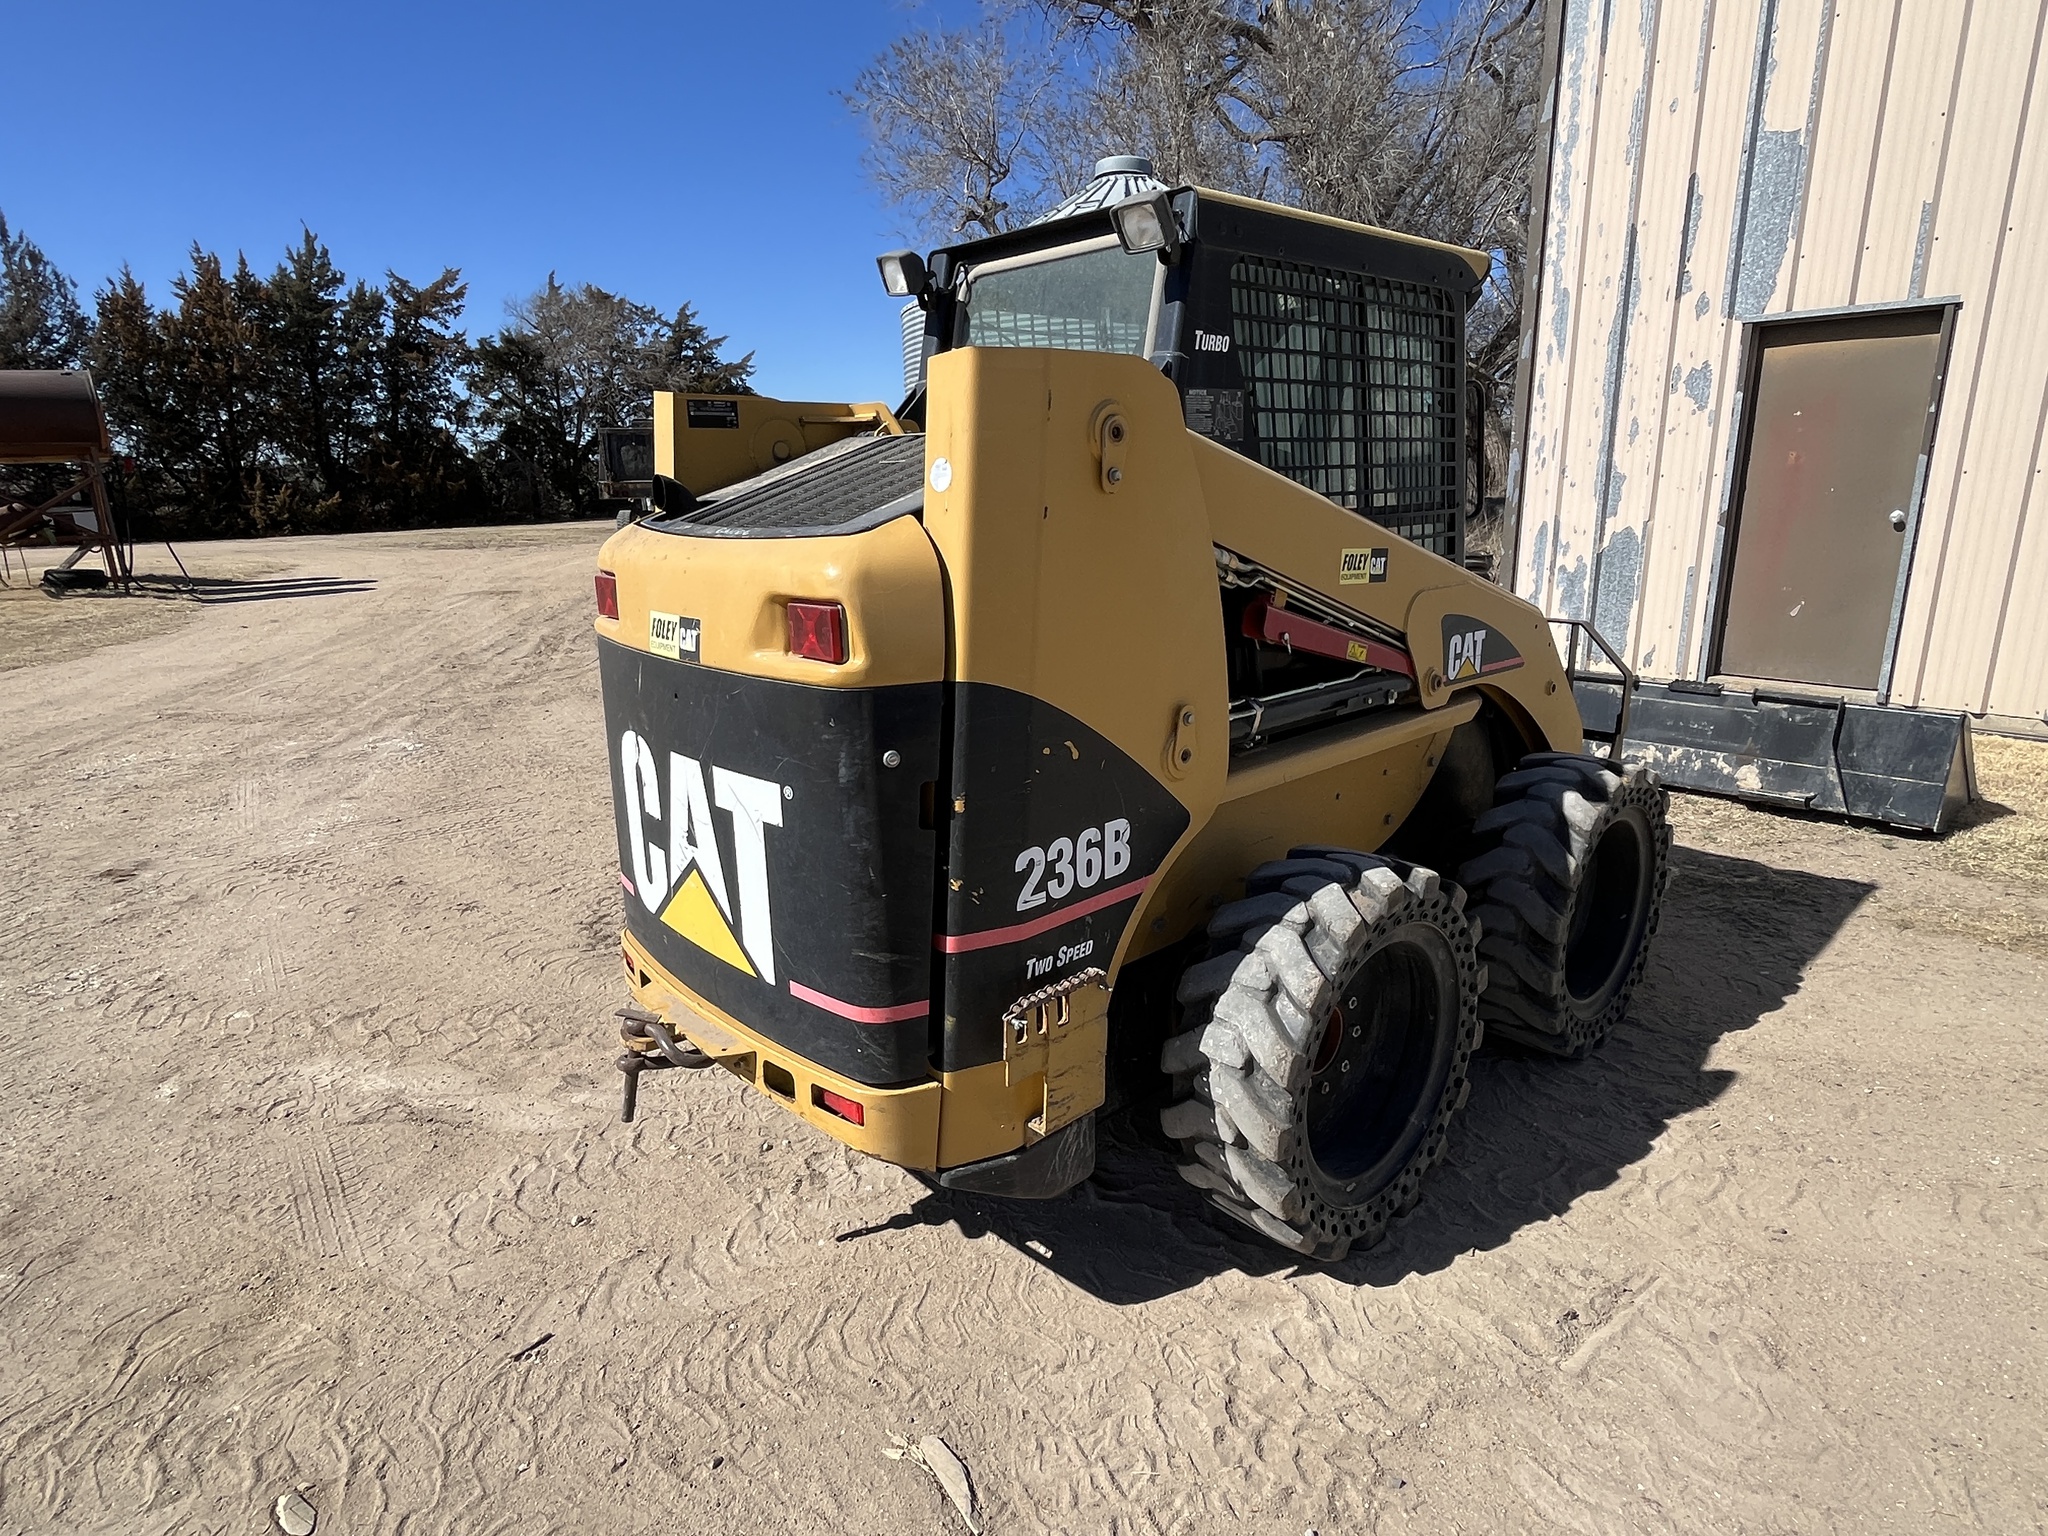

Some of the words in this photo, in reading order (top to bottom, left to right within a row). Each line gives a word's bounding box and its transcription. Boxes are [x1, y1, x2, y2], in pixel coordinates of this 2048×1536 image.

[1195, 330, 1230, 352] TURBO
[1341, 553, 1370, 572] FOLEY
[1370, 557, 1387, 575] CAT
[651, 617, 678, 642] FOLEY
[680, 627, 699, 652] CAT
[1447, 629, 1487, 681] CAT
[1014, 818, 1131, 912] 236B
[1026, 955, 1054, 980] TWO
[1056, 939, 1094, 968] SPEED
